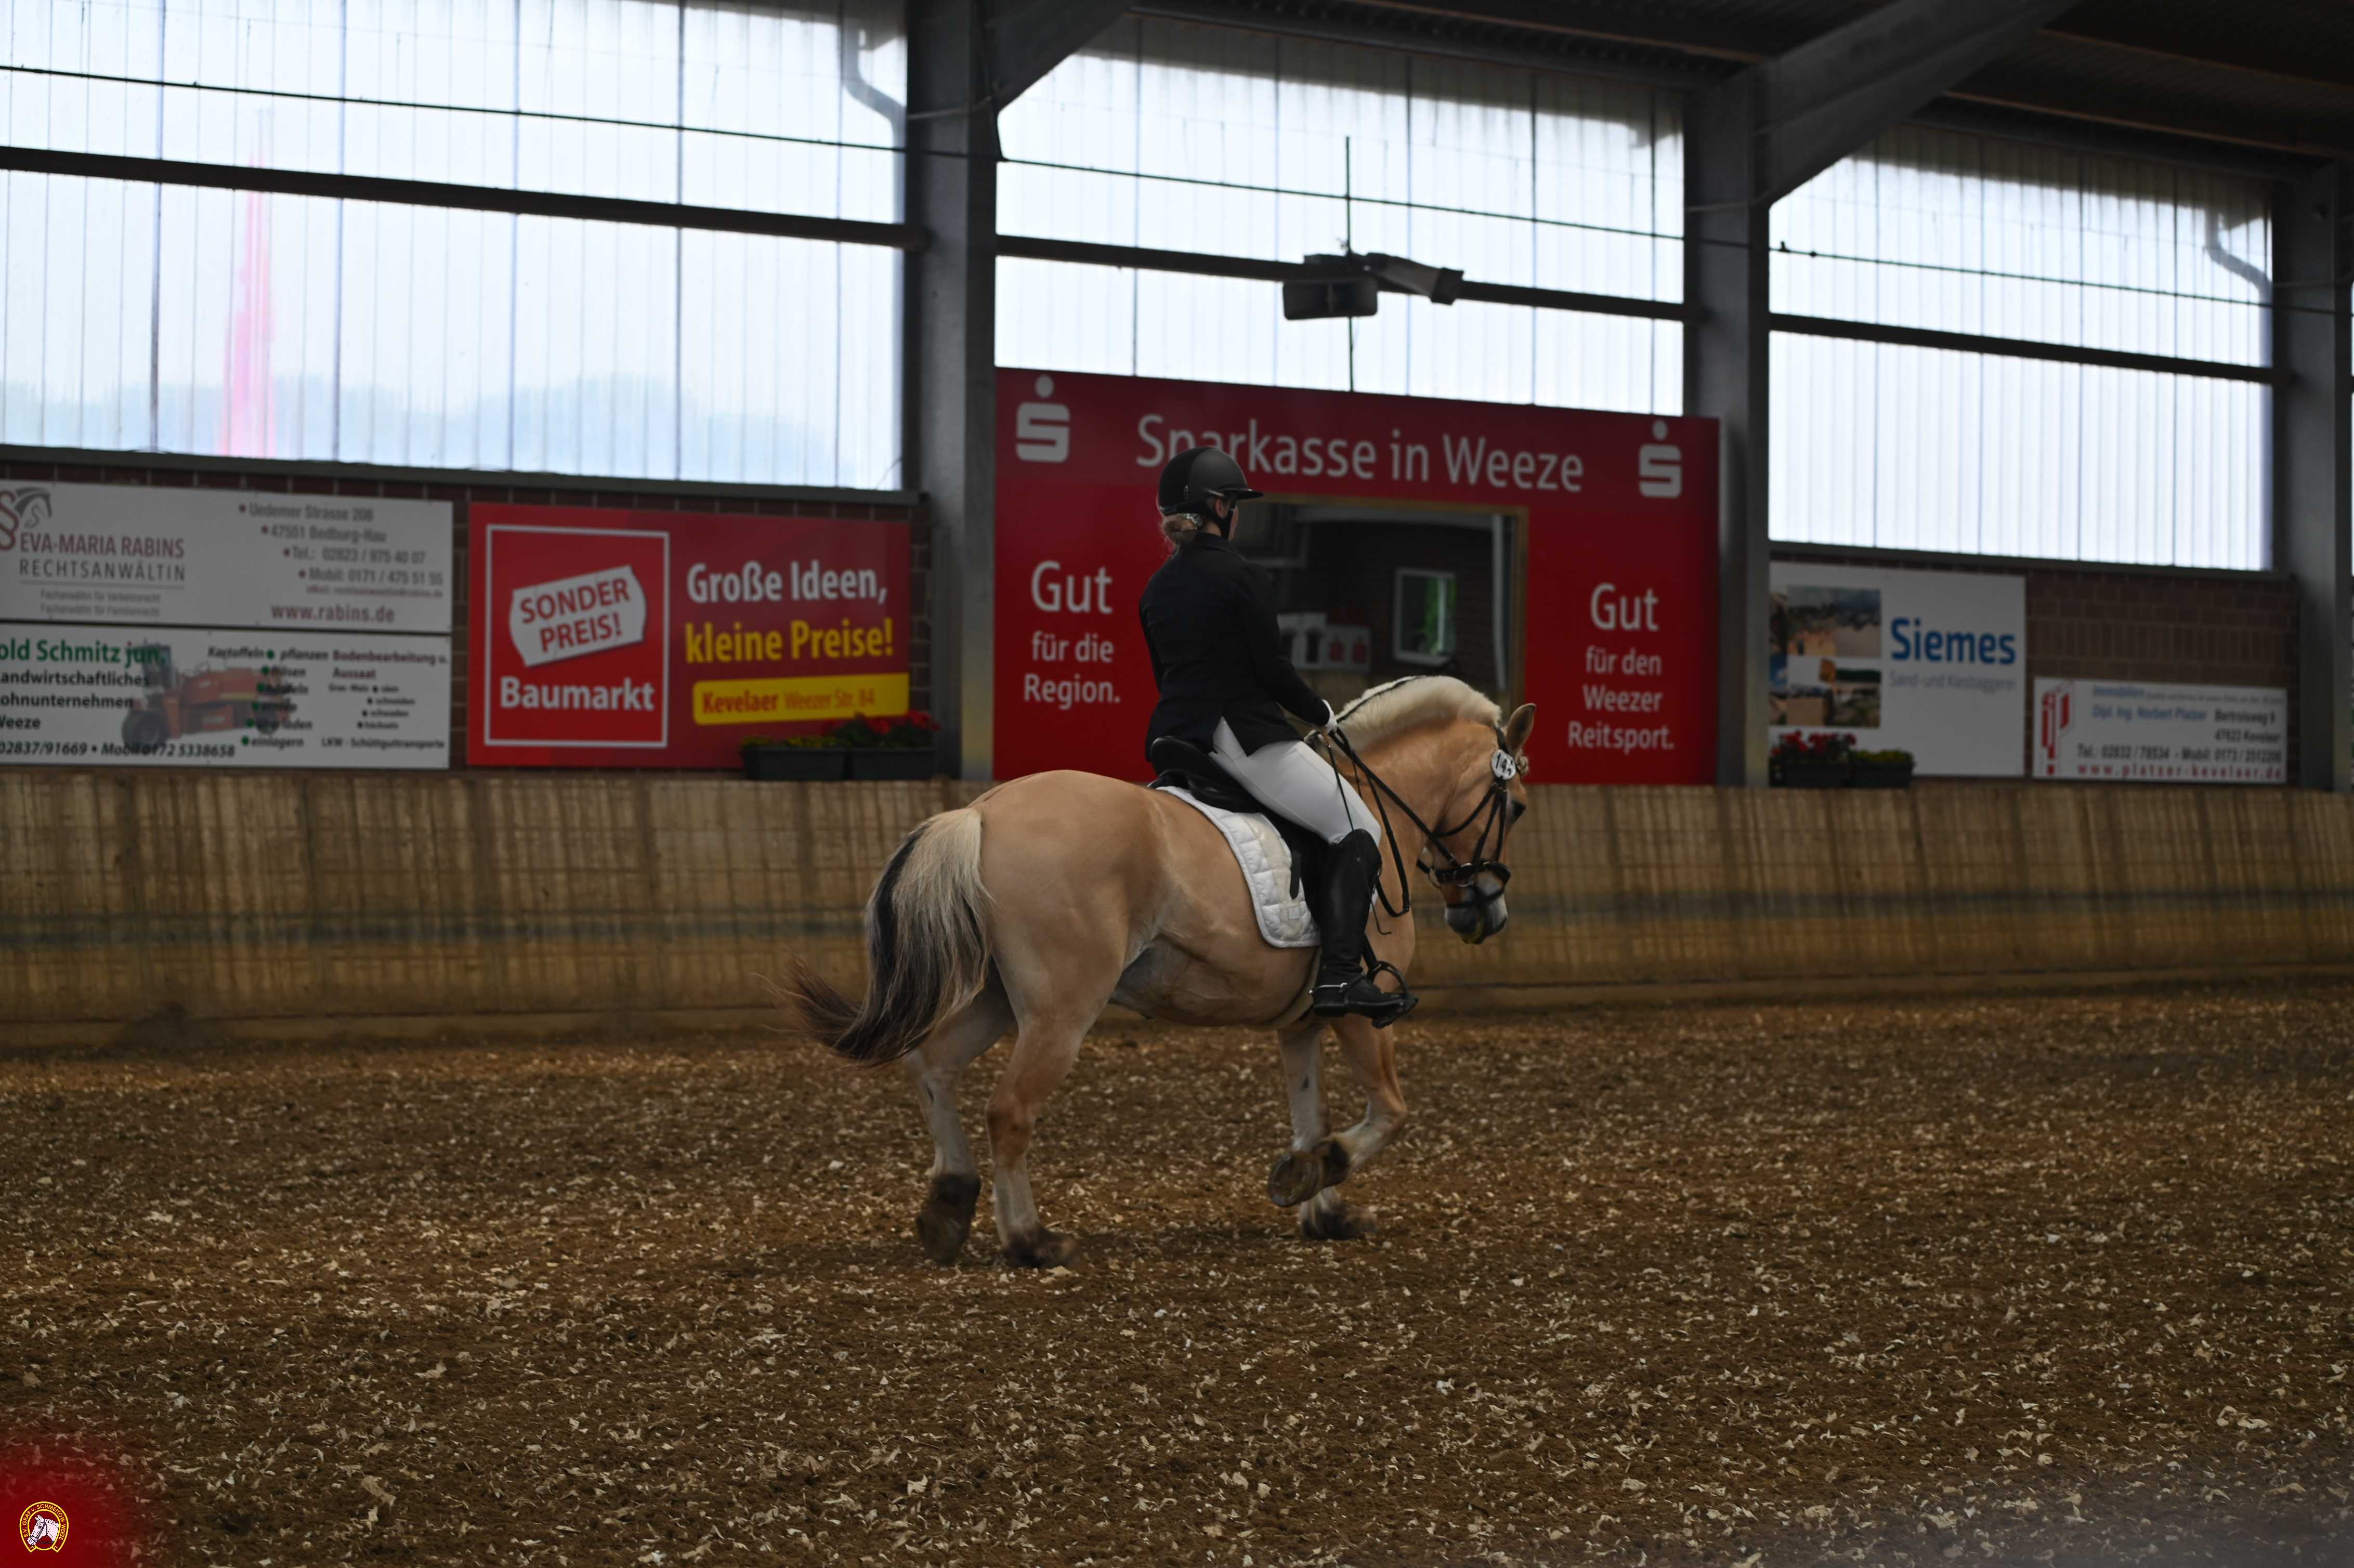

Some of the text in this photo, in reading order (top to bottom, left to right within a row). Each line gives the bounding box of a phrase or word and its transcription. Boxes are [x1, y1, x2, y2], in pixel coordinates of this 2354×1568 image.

[1391, 429, 1430, 483] in
[1443, 436, 1584, 493] Weeze
[122, 536, 185, 558] RABINS
[19, 558, 185, 582] RECHTSANWÄLTIN
[686, 559, 888, 604] Große Ideen,
[519, 578, 632, 624] SONDER
[1031, 560, 1113, 616] Gut
[271, 604, 395, 622] www.rabins.de
[1590, 583, 1659, 632] Gut
[539, 612, 623, 654] PREIS!
[685, 617, 894, 664] kleine Preise!
[1031, 631, 1114, 664] für die
[1890, 617, 2016, 665] Siemes
[36, 639, 121, 663] Schmitz
[125, 642, 166, 668] jun.
[207, 647, 264, 660] Kartoffeln
[280, 647, 329, 661] pflanzen
[333, 649, 436, 665] Bodenbearbeitung
[1587, 644, 1662, 677] für den
[0, 670, 150, 687] andwirtschaftliches
[333, 667, 376, 678] Aussaat
[0, 691, 134, 708] ohnunternehmen
[500, 676, 655, 711] Baumarkt
[702, 690, 778, 715] Kevelaer
[1023, 674, 1121, 712] Region.
[1582, 684, 1663, 714] Weezer
[1567, 720, 1675, 756] Reitsport.
